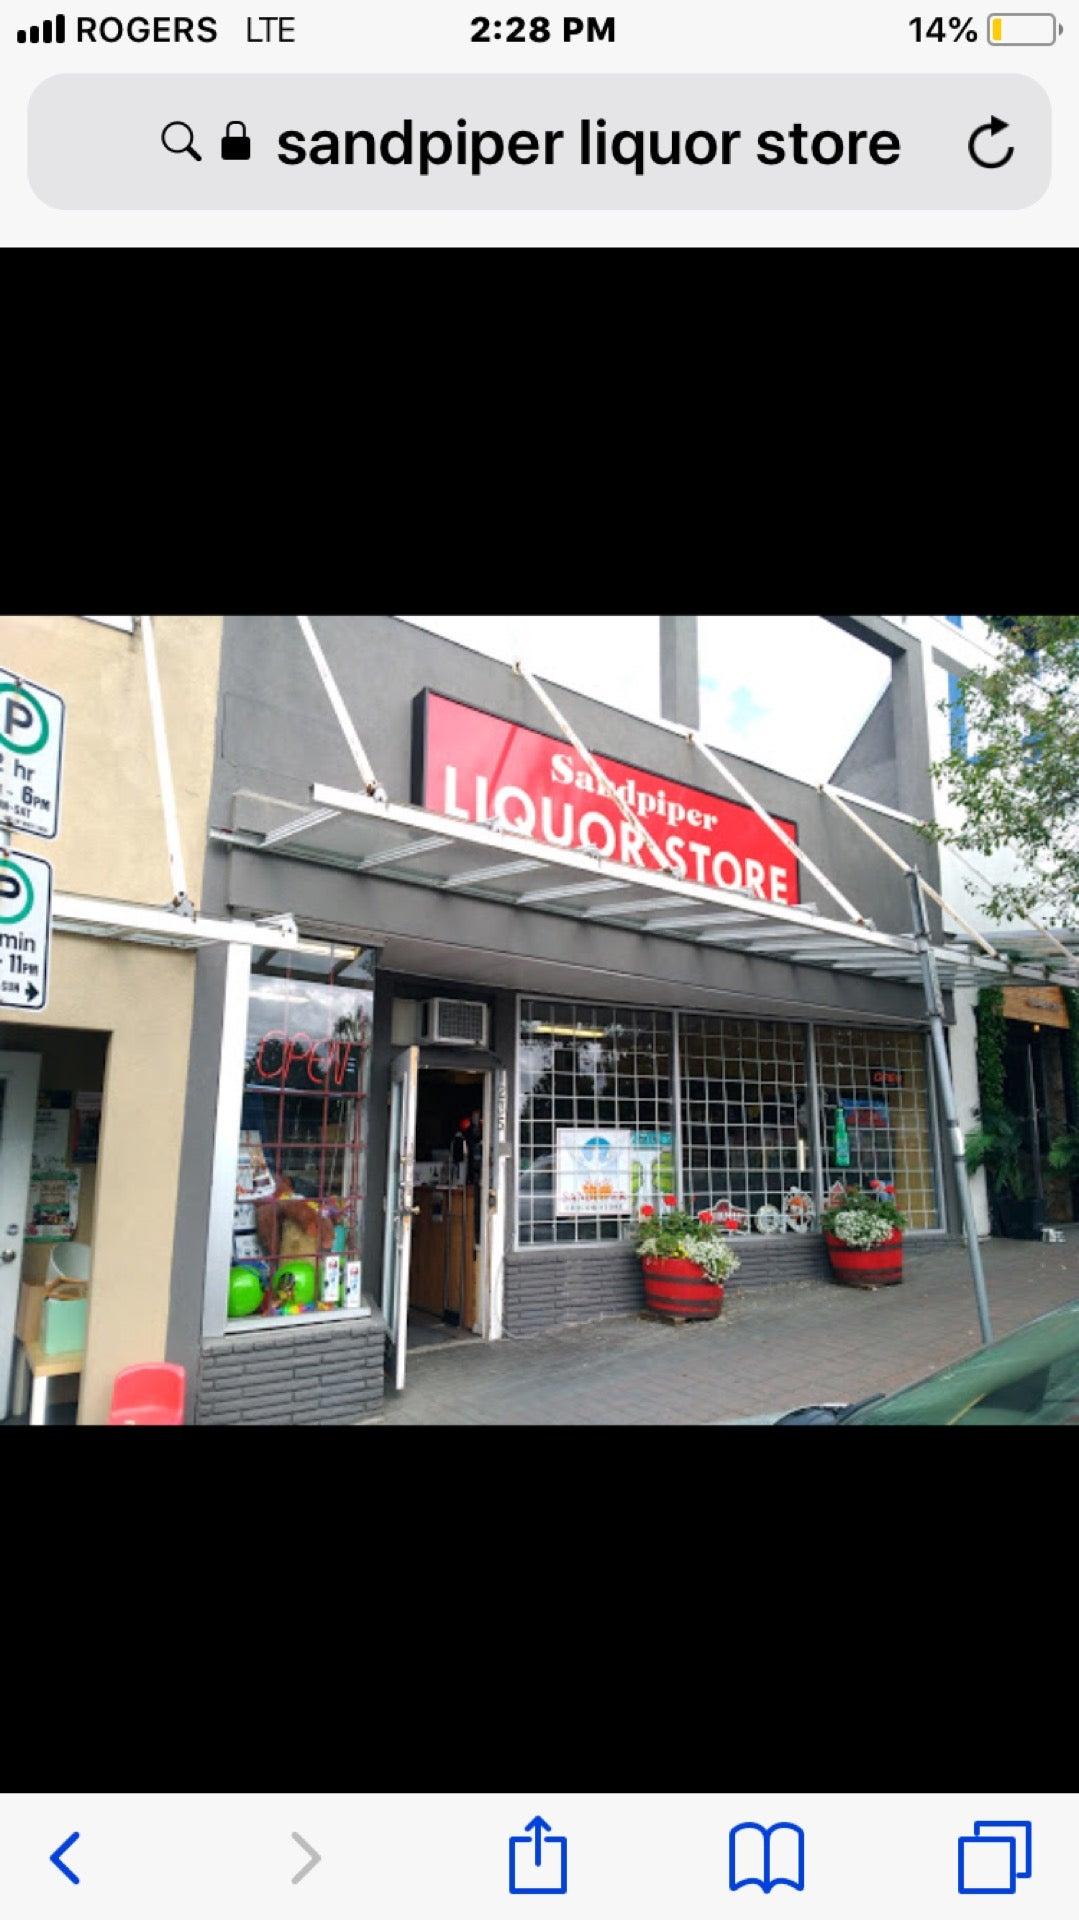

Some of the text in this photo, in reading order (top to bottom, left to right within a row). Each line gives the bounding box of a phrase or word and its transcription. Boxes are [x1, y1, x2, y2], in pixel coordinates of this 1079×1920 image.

[4, 697, 33, 735] P
[13, 758, 36, 782] hr
[22, 785, 50, 812] 6PM
[551, 753, 719, 831] Sandpiper
[444, 765, 789, 905] LIQUOR STORE
[0, 931, 36, 953] min
[9, 953, 39, 976] 11PM
[256, 1030, 352, 1086] OPEN
